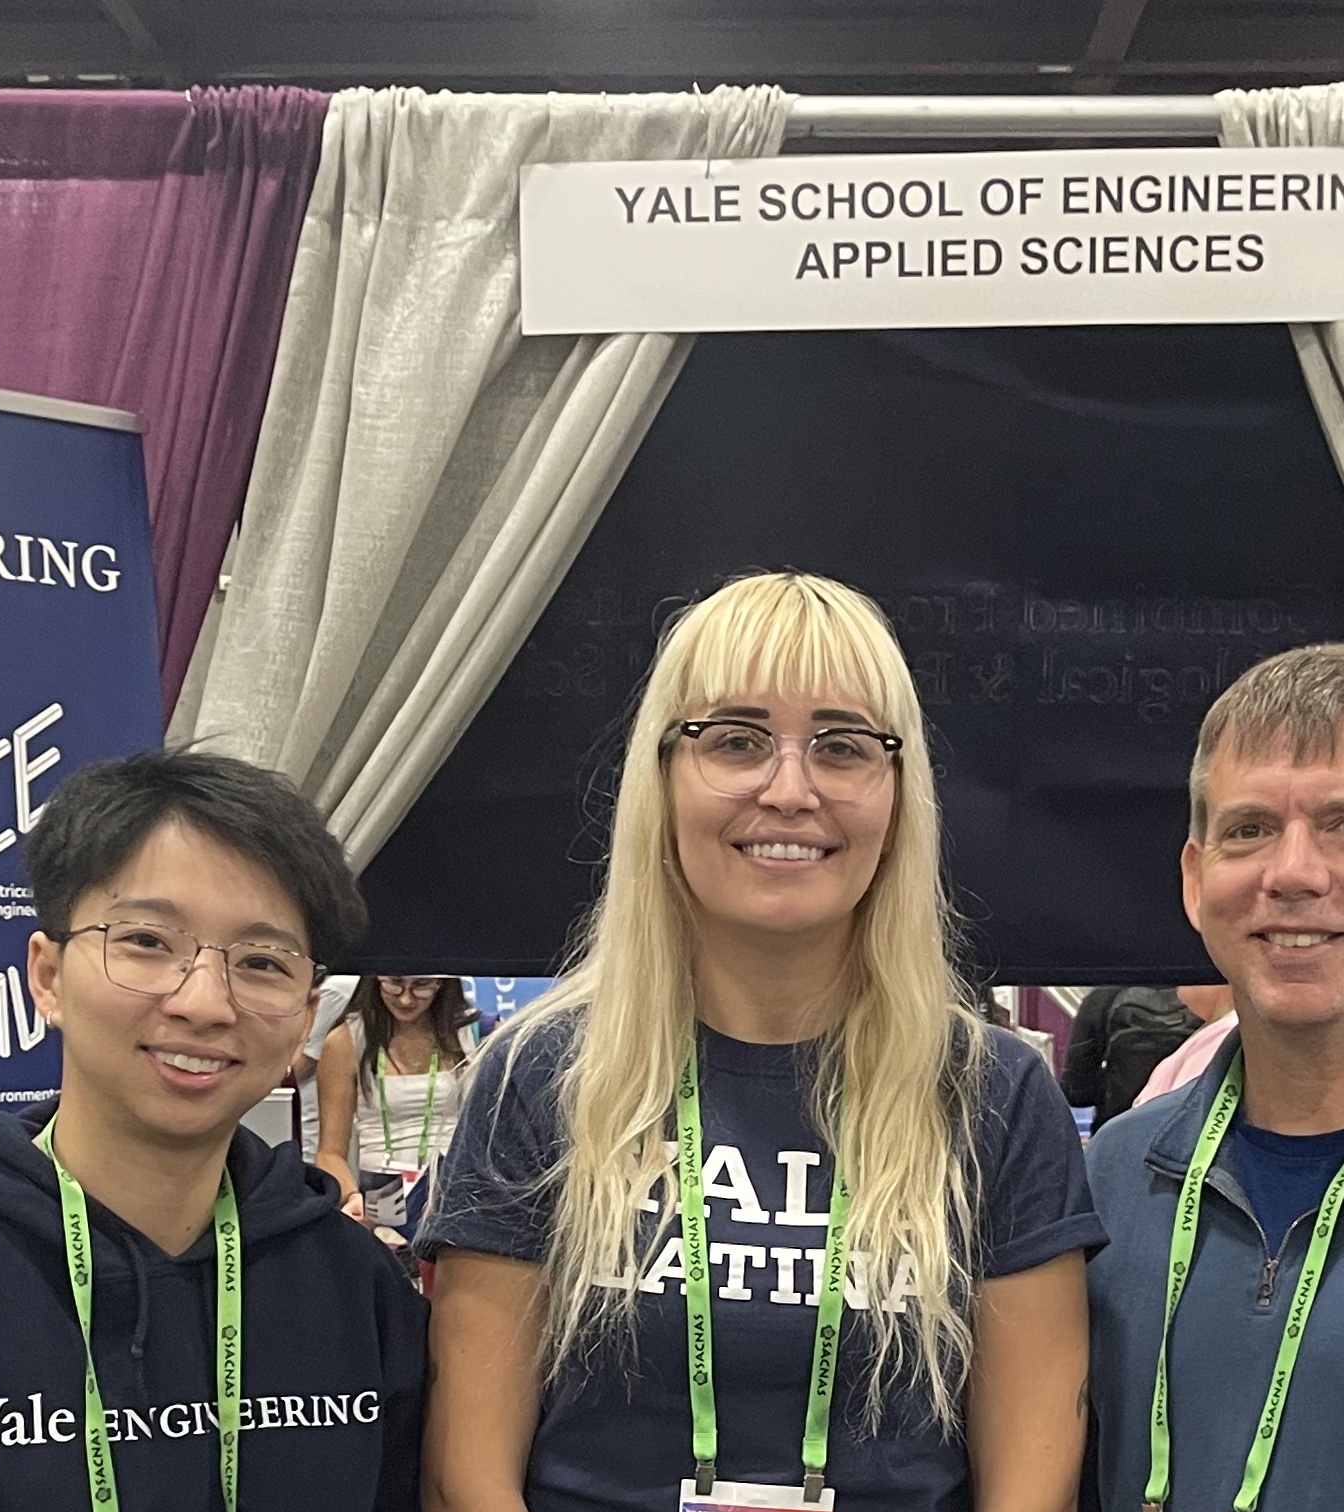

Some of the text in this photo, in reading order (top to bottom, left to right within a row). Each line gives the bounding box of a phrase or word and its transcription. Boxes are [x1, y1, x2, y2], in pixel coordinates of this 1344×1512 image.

[617, 181, 741, 225] YALE
[758, 178, 963, 222] SCHOOL
[980, 176, 1045, 218] OF
[796, 232, 1266, 281] APPLIED SCIENCES
[1207, 1093, 1238, 1142] SACNAS
[1181, 1179, 1200, 1233] SACNAS
[71, 1211, 87, 1270] SACNAS
[223, 1235, 237, 1293] SACNAS
[688, 1215, 699, 1266] SACNAS
[826, 1236, 845, 1293] SACNAS
[1291, 1269, 1315, 1327] SACNAS
[694, 1314, 705, 1369] SACNAS
[816, 1337, 834, 1397] SACNAS
[223, 1341, 237, 1399] SACNAS
[1266, 1370, 1286, 1424] SACNAS
[92, 1427, 112, 1490] SACNAS
